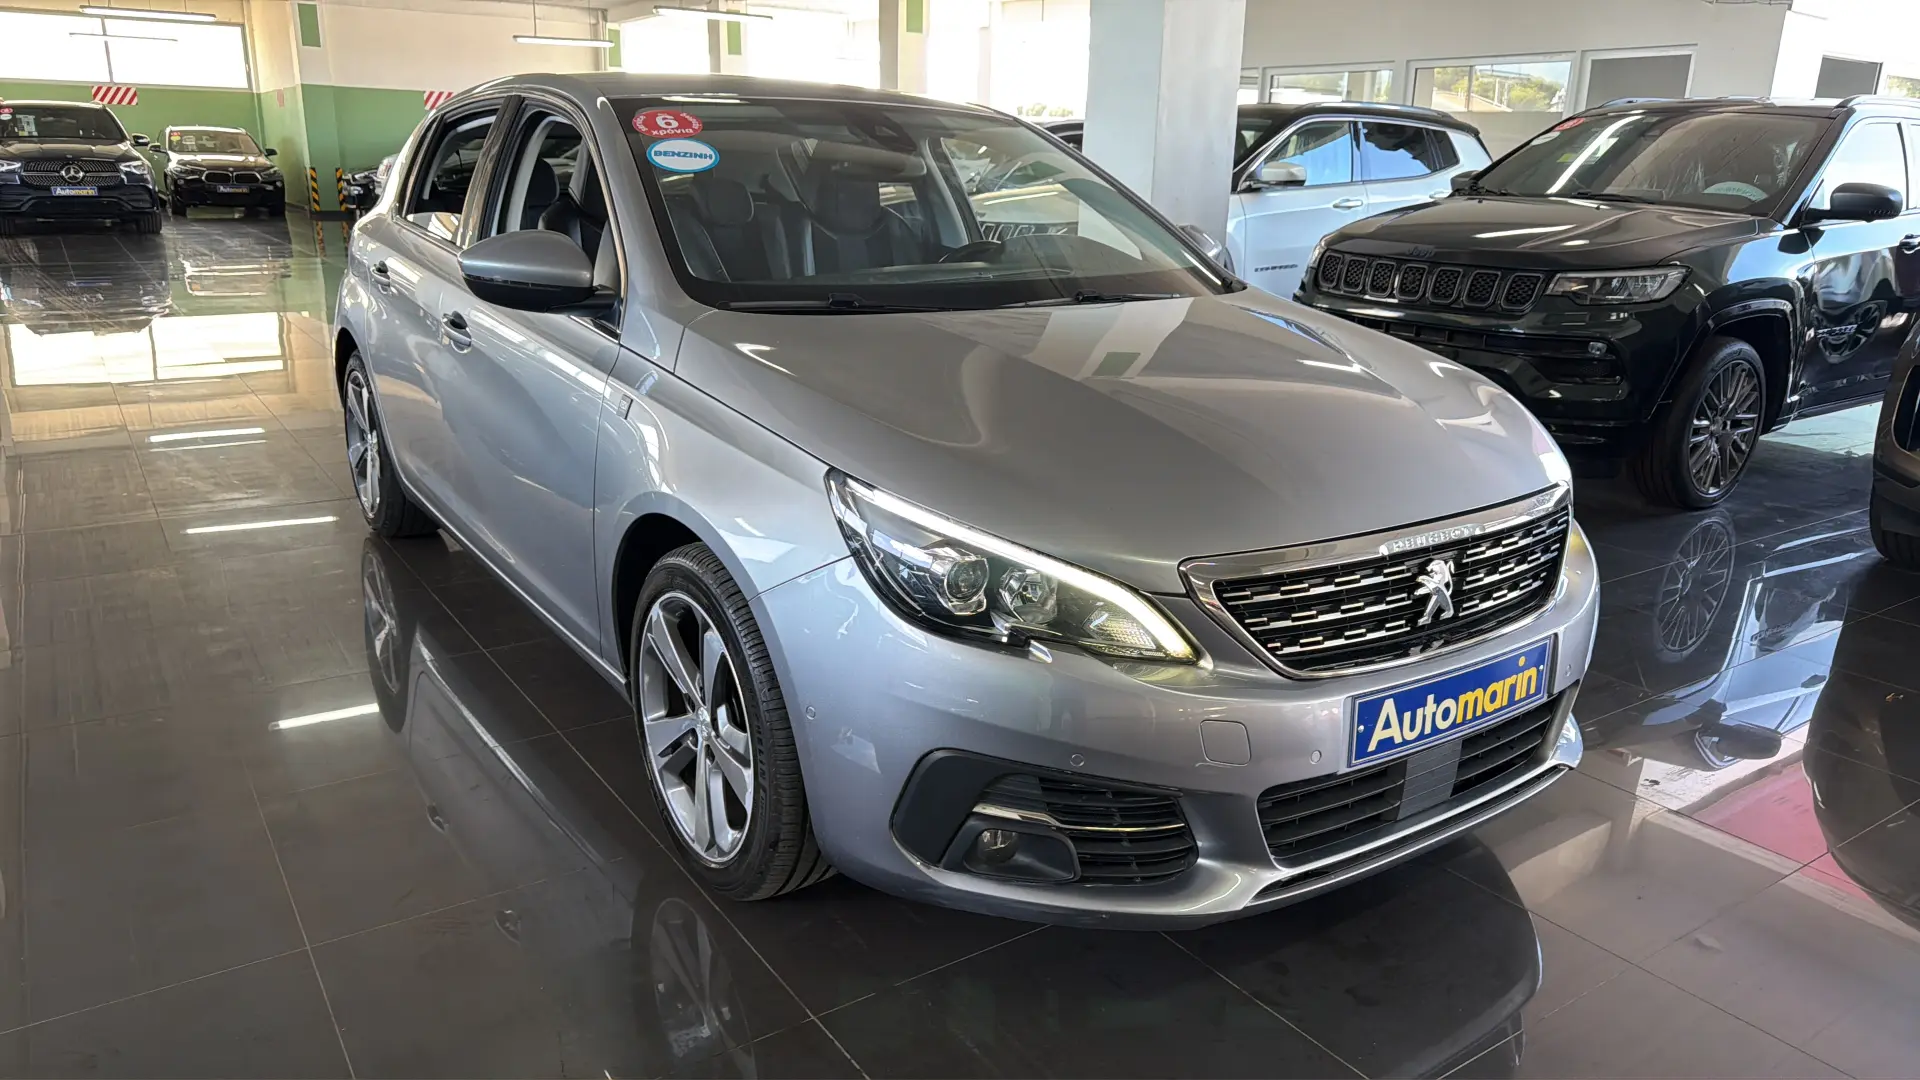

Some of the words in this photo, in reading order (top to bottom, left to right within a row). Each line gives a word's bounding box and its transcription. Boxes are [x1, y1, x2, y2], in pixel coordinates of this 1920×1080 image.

[655, 115, 679, 129] 6
[55, 187, 95, 195] Automarin
[1392, 527, 1473, 552] PEUGEOT
[1367, 655, 1538, 753] Automarin
